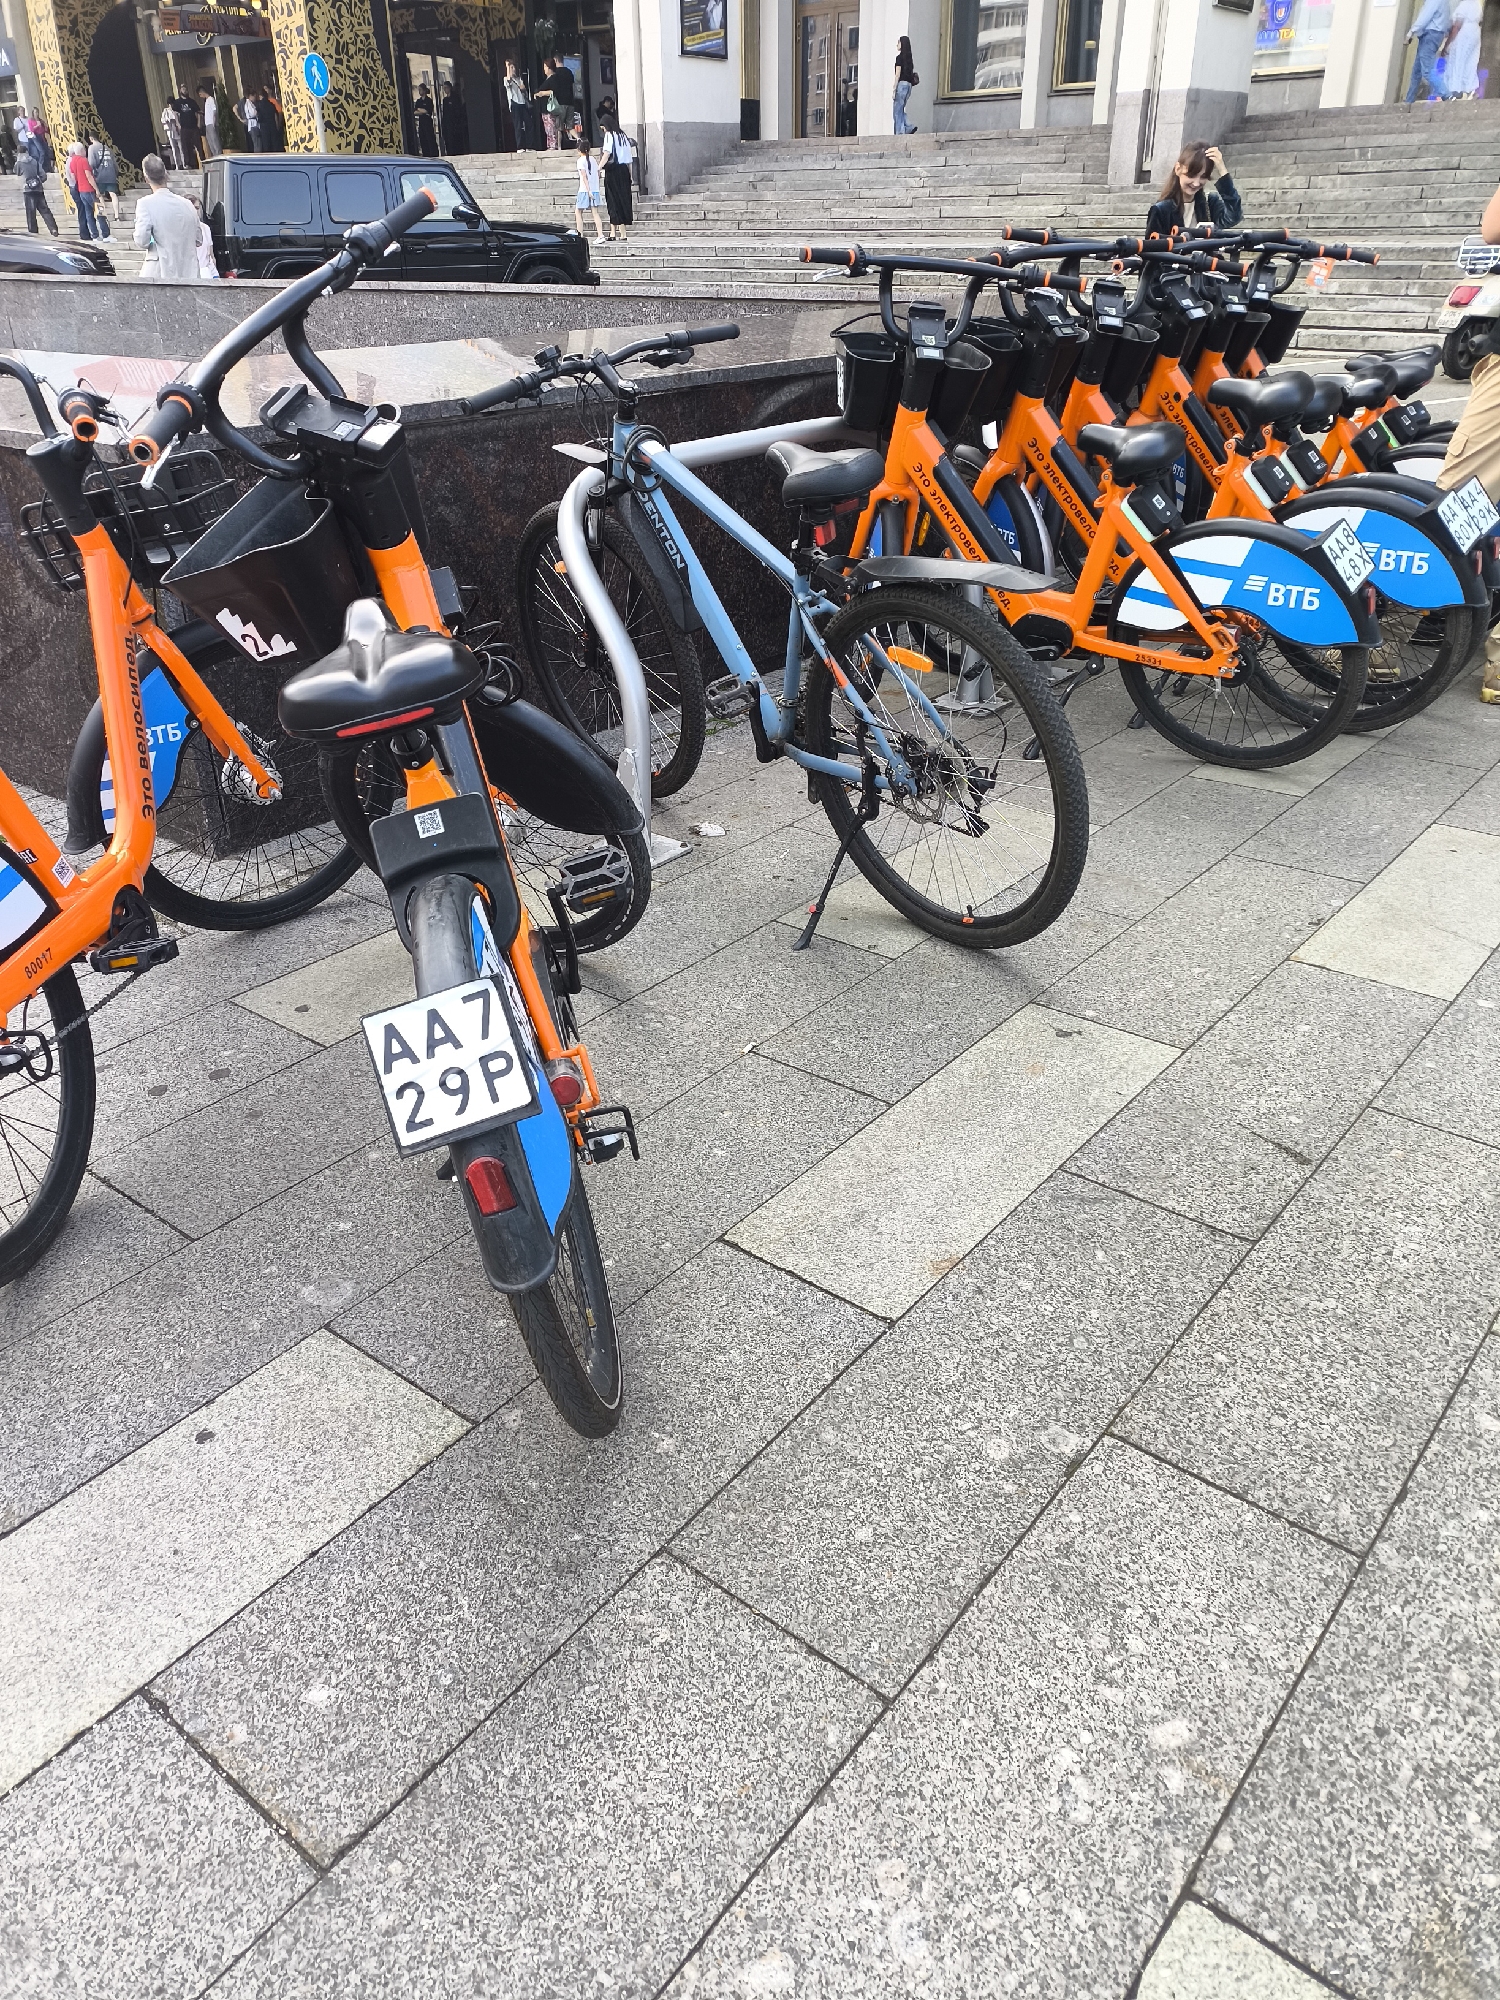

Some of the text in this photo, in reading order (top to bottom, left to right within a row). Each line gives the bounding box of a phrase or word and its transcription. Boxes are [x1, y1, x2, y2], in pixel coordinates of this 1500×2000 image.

[1160, 391, 1175, 411] Это
[1027, 437, 1045, 462] Это
[912, 461, 931, 488] Это
[1378, 549, 1431, 576] ВТБ
[1267, 582, 1321, 611] ВТБ
[141, 777, 156, 821] Это
[383, 988, 491, 1076] АА7
[395, 1049, 514, 1134] 29Р
